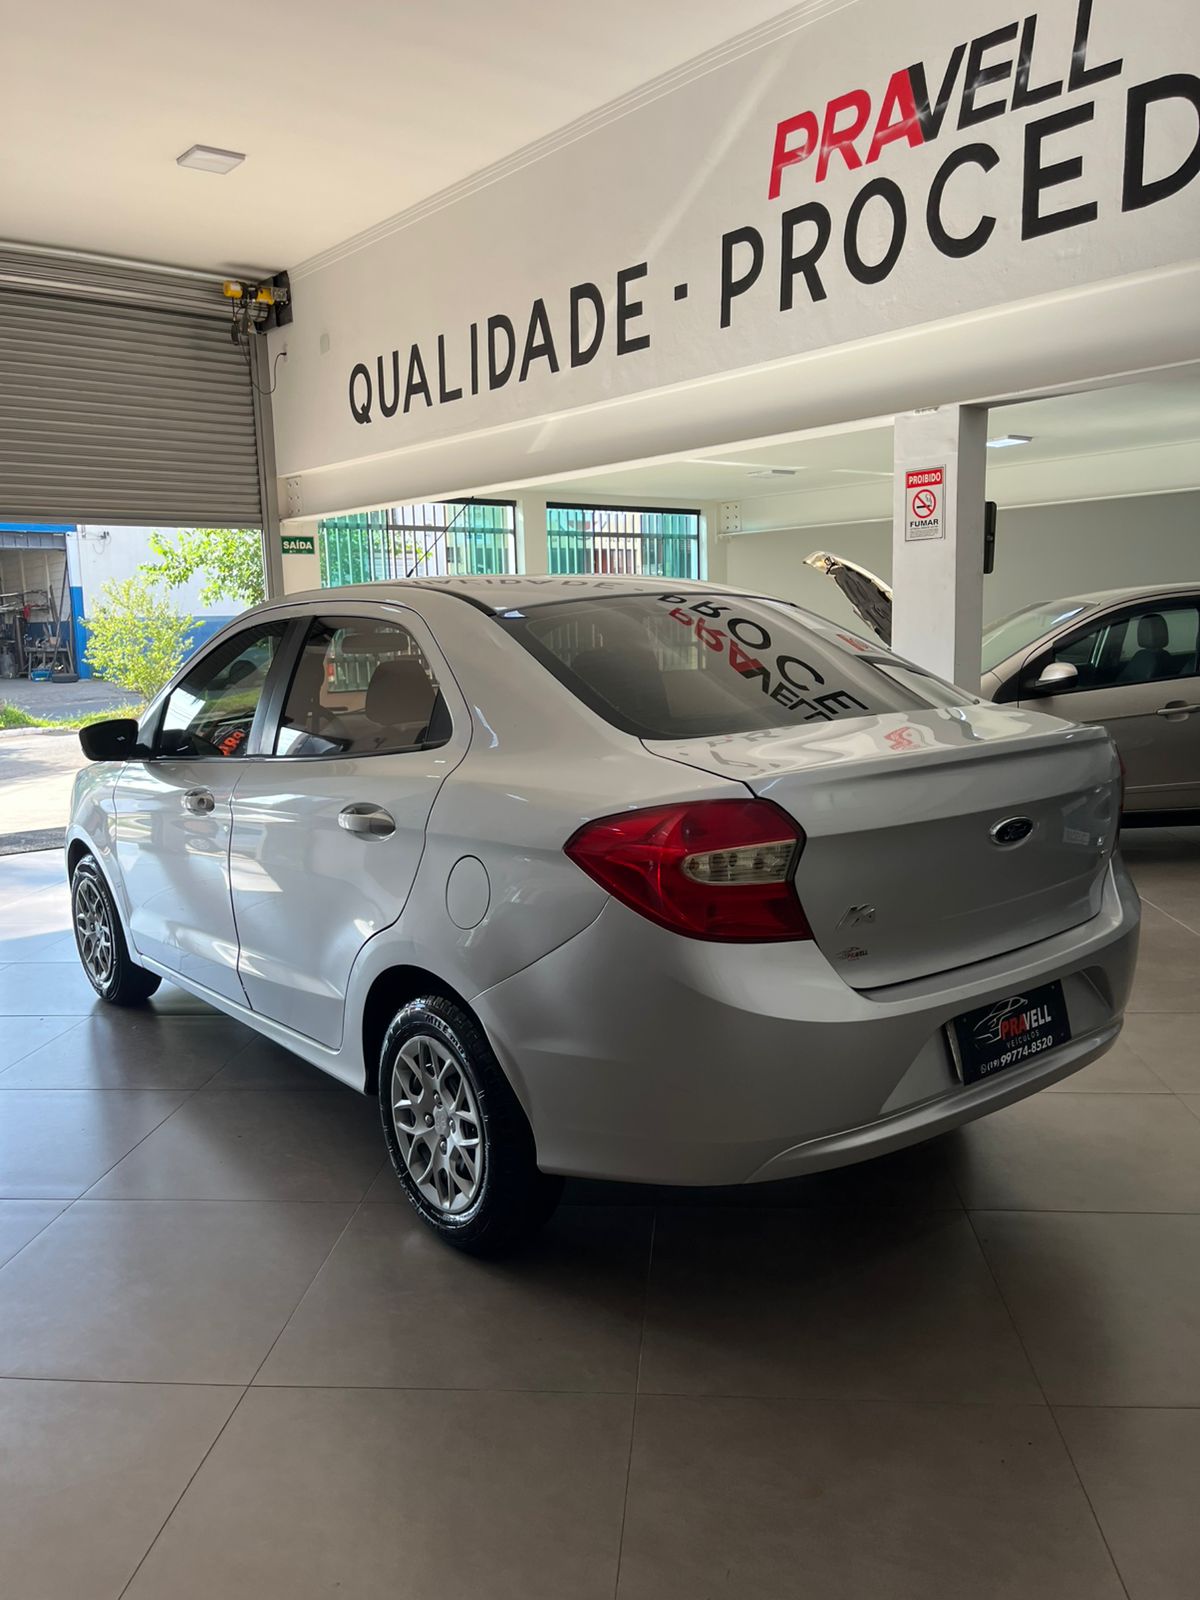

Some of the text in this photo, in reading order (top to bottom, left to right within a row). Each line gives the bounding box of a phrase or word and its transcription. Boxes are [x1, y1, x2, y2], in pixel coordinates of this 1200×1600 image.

[768, 0, 1124, 200] PRAVELL
[348, 261, 651, 425] QUALIDADE
[720, 73, 1200, 329] PROCED
[908, 471, 942, 485] PROIBIDO
[909, 518, 939, 528] FUMAR
[283, 539, 313, 550] SAÍDA
[1001, 1004, 1052, 1040] PRAVELL
[1000, 1035, 1053, 1067] 99774-8520
